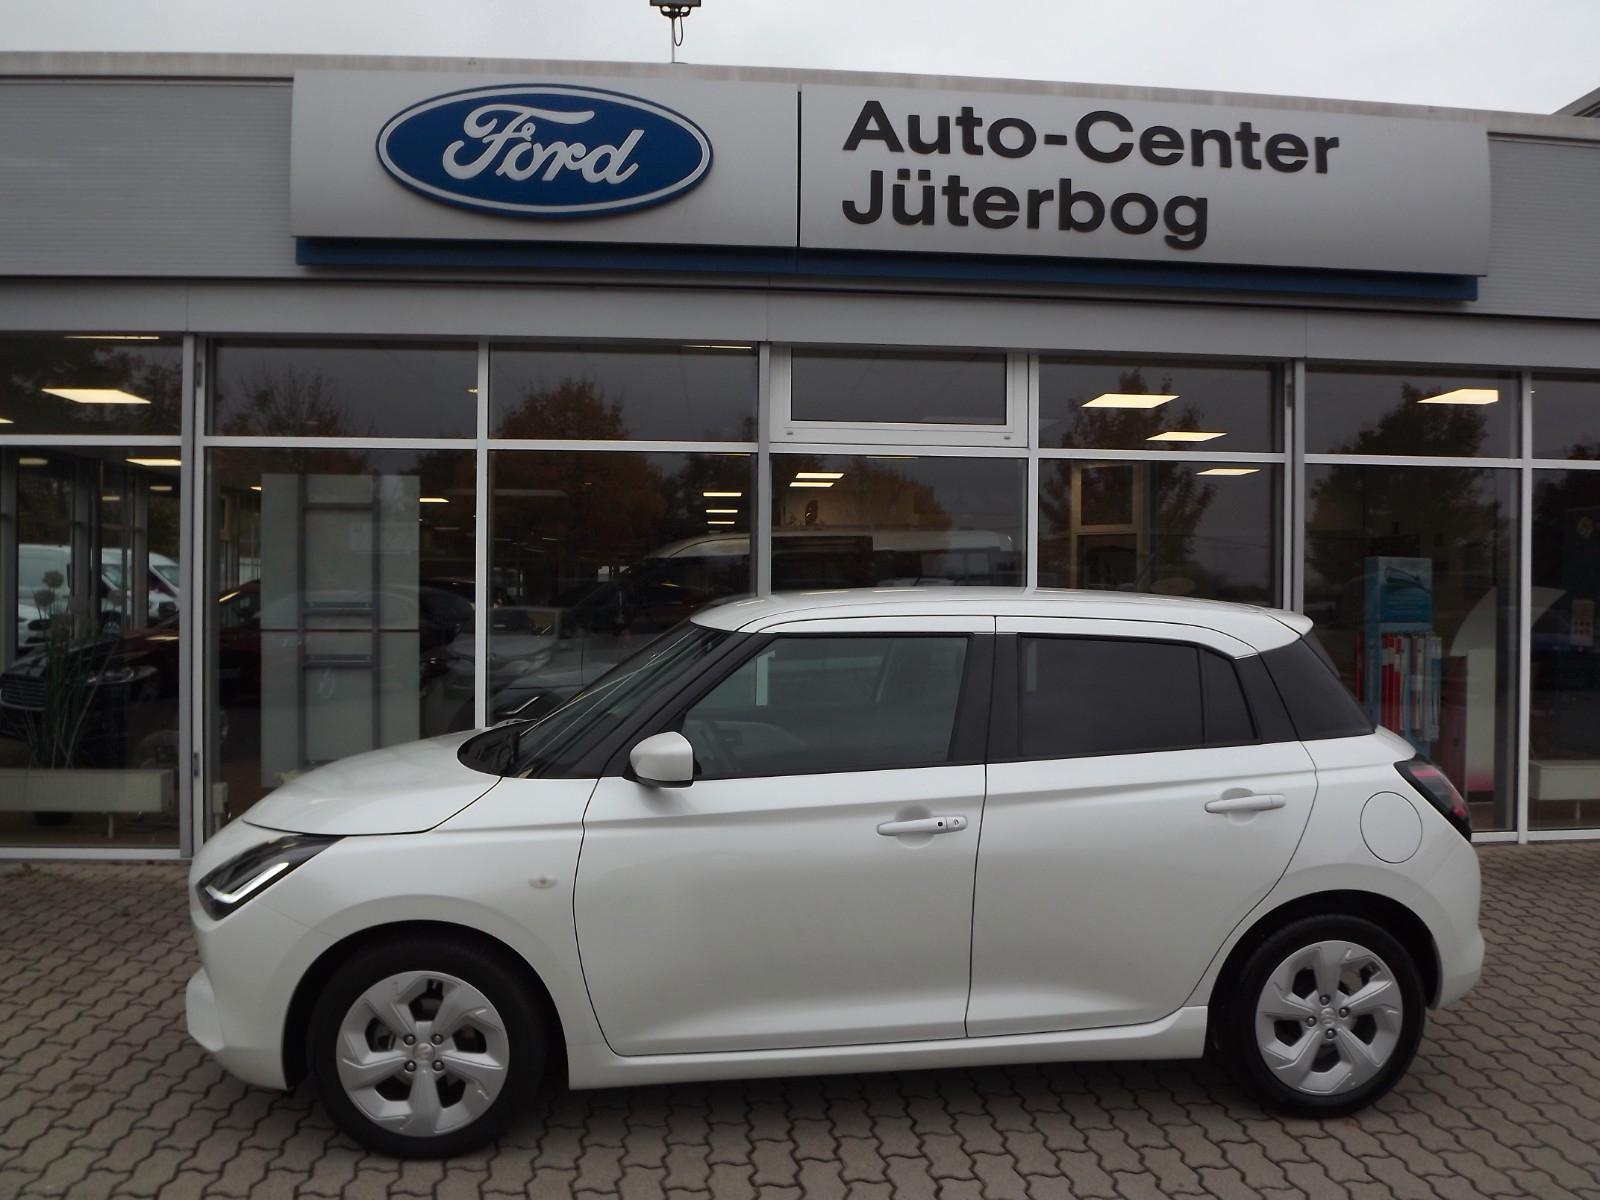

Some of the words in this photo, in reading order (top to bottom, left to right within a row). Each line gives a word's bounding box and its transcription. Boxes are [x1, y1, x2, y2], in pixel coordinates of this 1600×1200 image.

[442, 103, 645, 185] Ford
[843, 100, 1339, 174] Auto-Center
[842, 169, 1209, 250] Jüterbog
